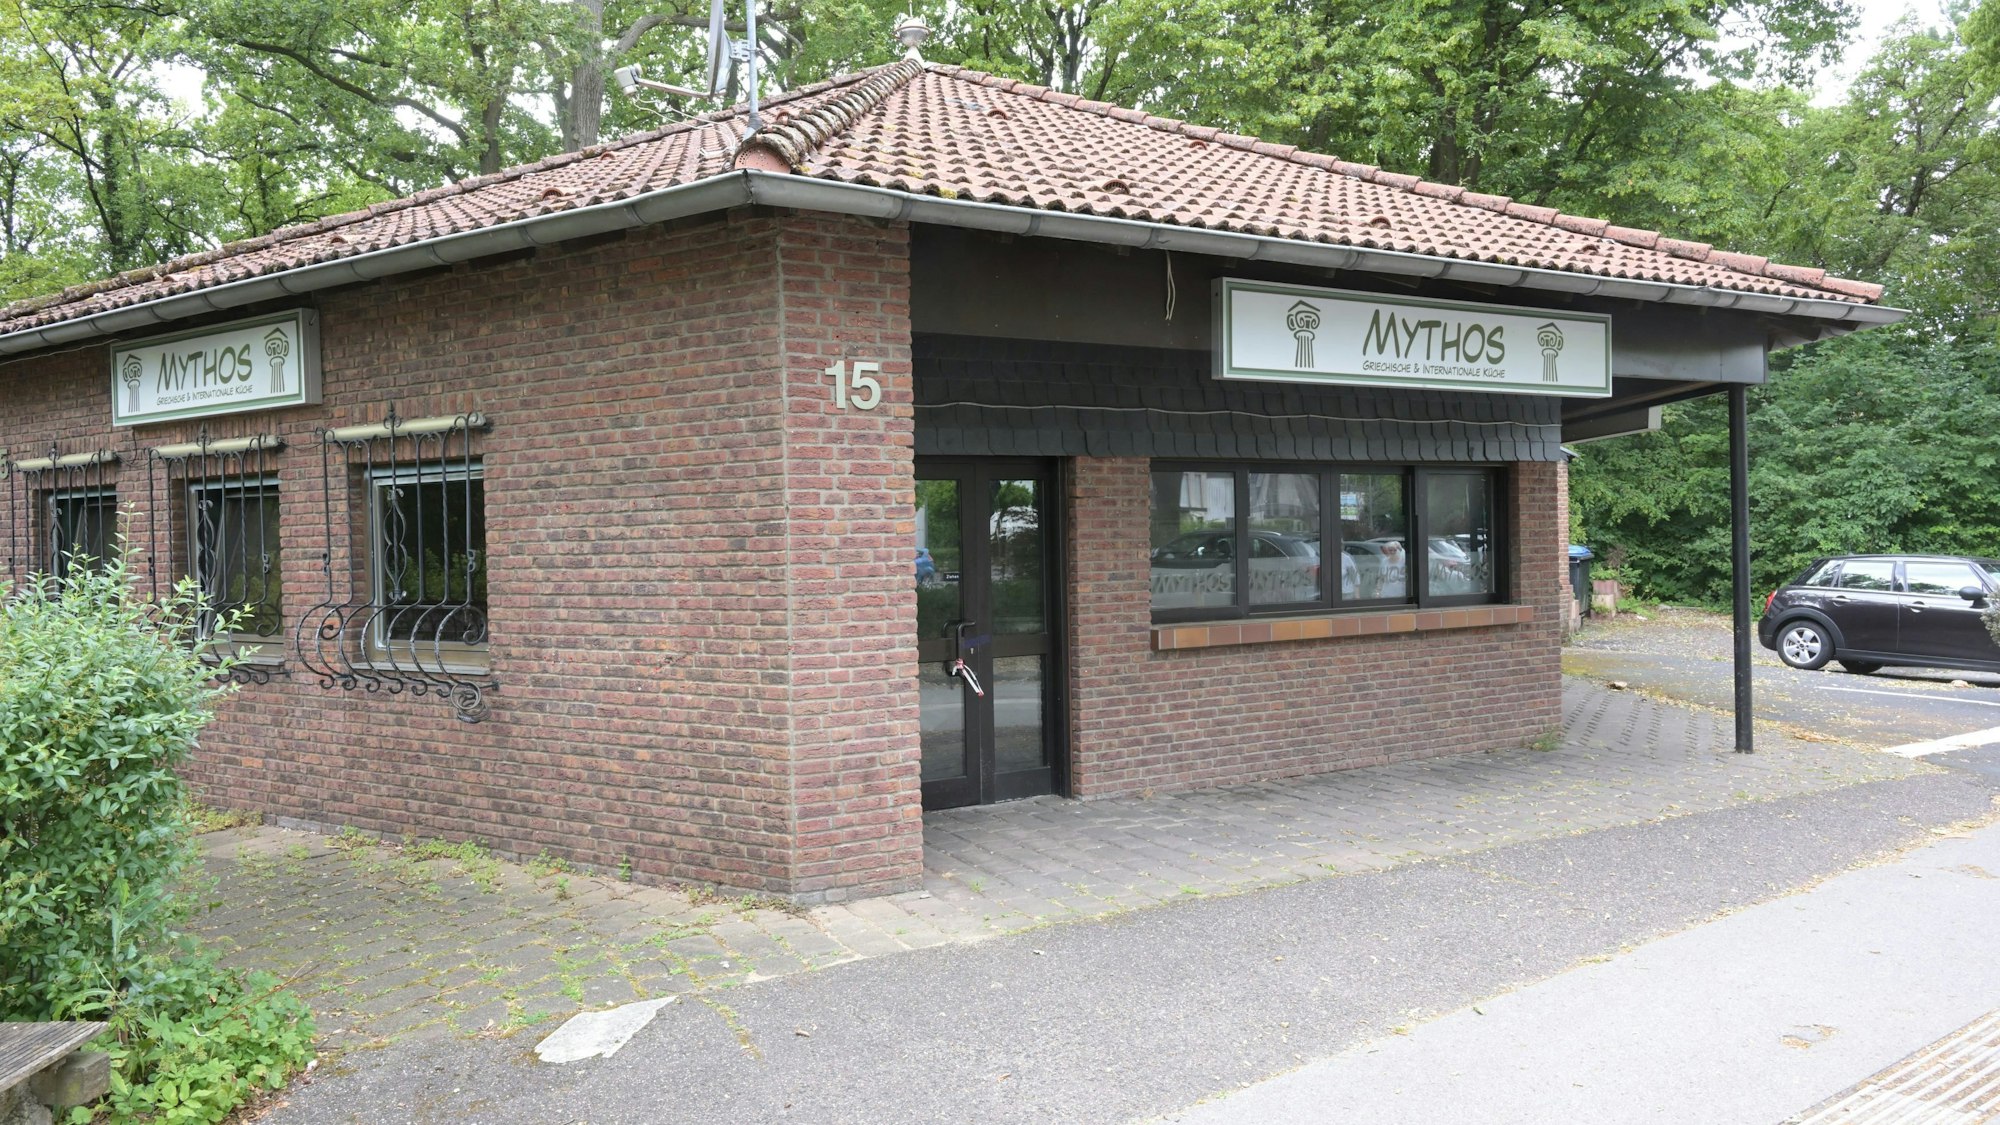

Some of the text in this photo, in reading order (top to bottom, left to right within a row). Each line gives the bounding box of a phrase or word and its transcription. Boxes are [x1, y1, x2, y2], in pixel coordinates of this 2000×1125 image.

[1362, 309, 1505, 365] MYTHOS
[157, 343, 252, 394] MYTHOS
[825, 360, 881, 410] 15
[1362, 360, 1506, 378] GRIECHISCHE & INTERNATIONALE KÜCHE
[157, 394, 185, 405] GRIECHISCHE
[192, 387, 234, 401] INTERNATIONALE
[236, 385, 253, 395] KÜCHE
[1154, 572, 1231, 594] MYTHOS
